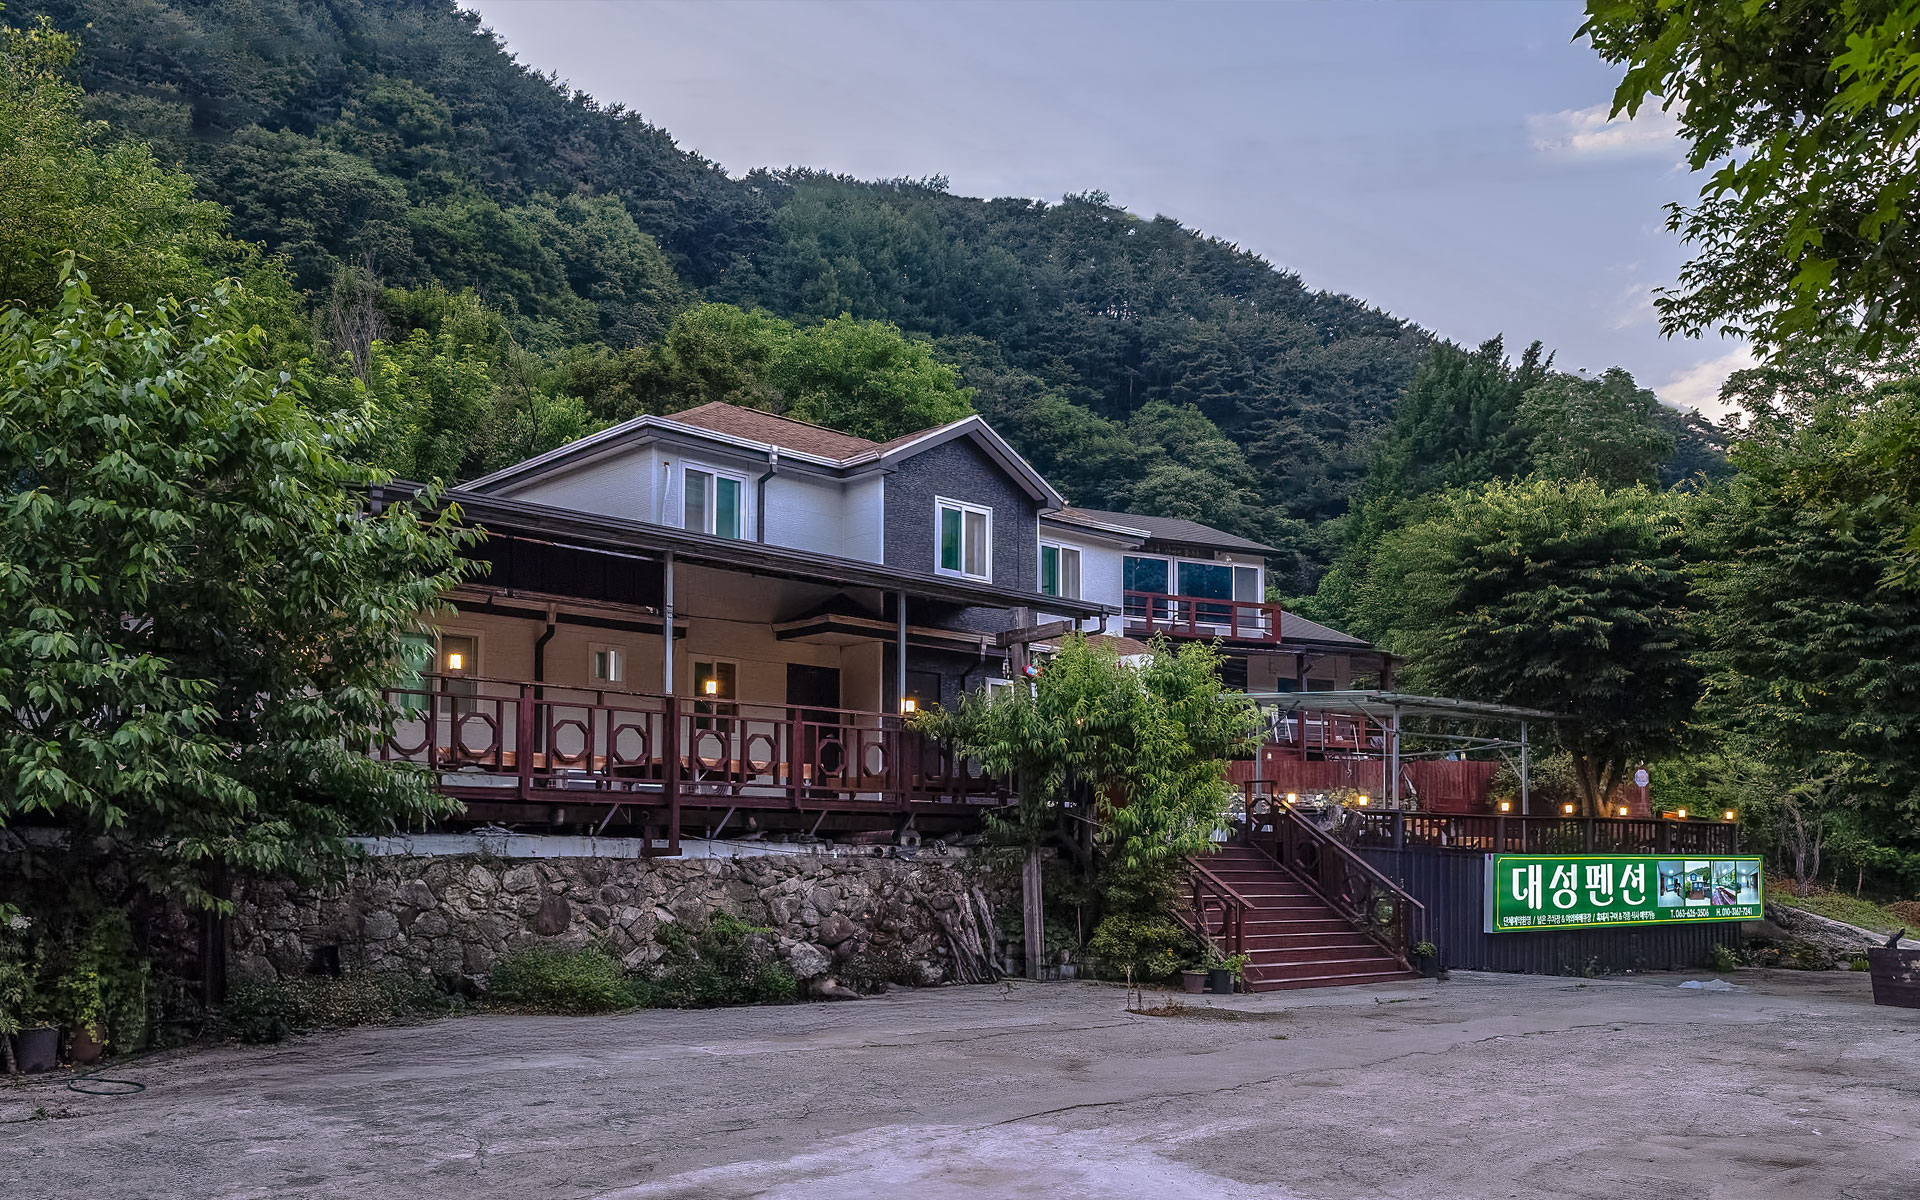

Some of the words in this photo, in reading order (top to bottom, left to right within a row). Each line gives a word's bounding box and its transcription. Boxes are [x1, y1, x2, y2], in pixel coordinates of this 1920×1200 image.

[1512, 863, 1646, 910] 대성펜션
[1547, 914, 1561, 925] 주차장
[1610, 911, 1618, 921] 구이
